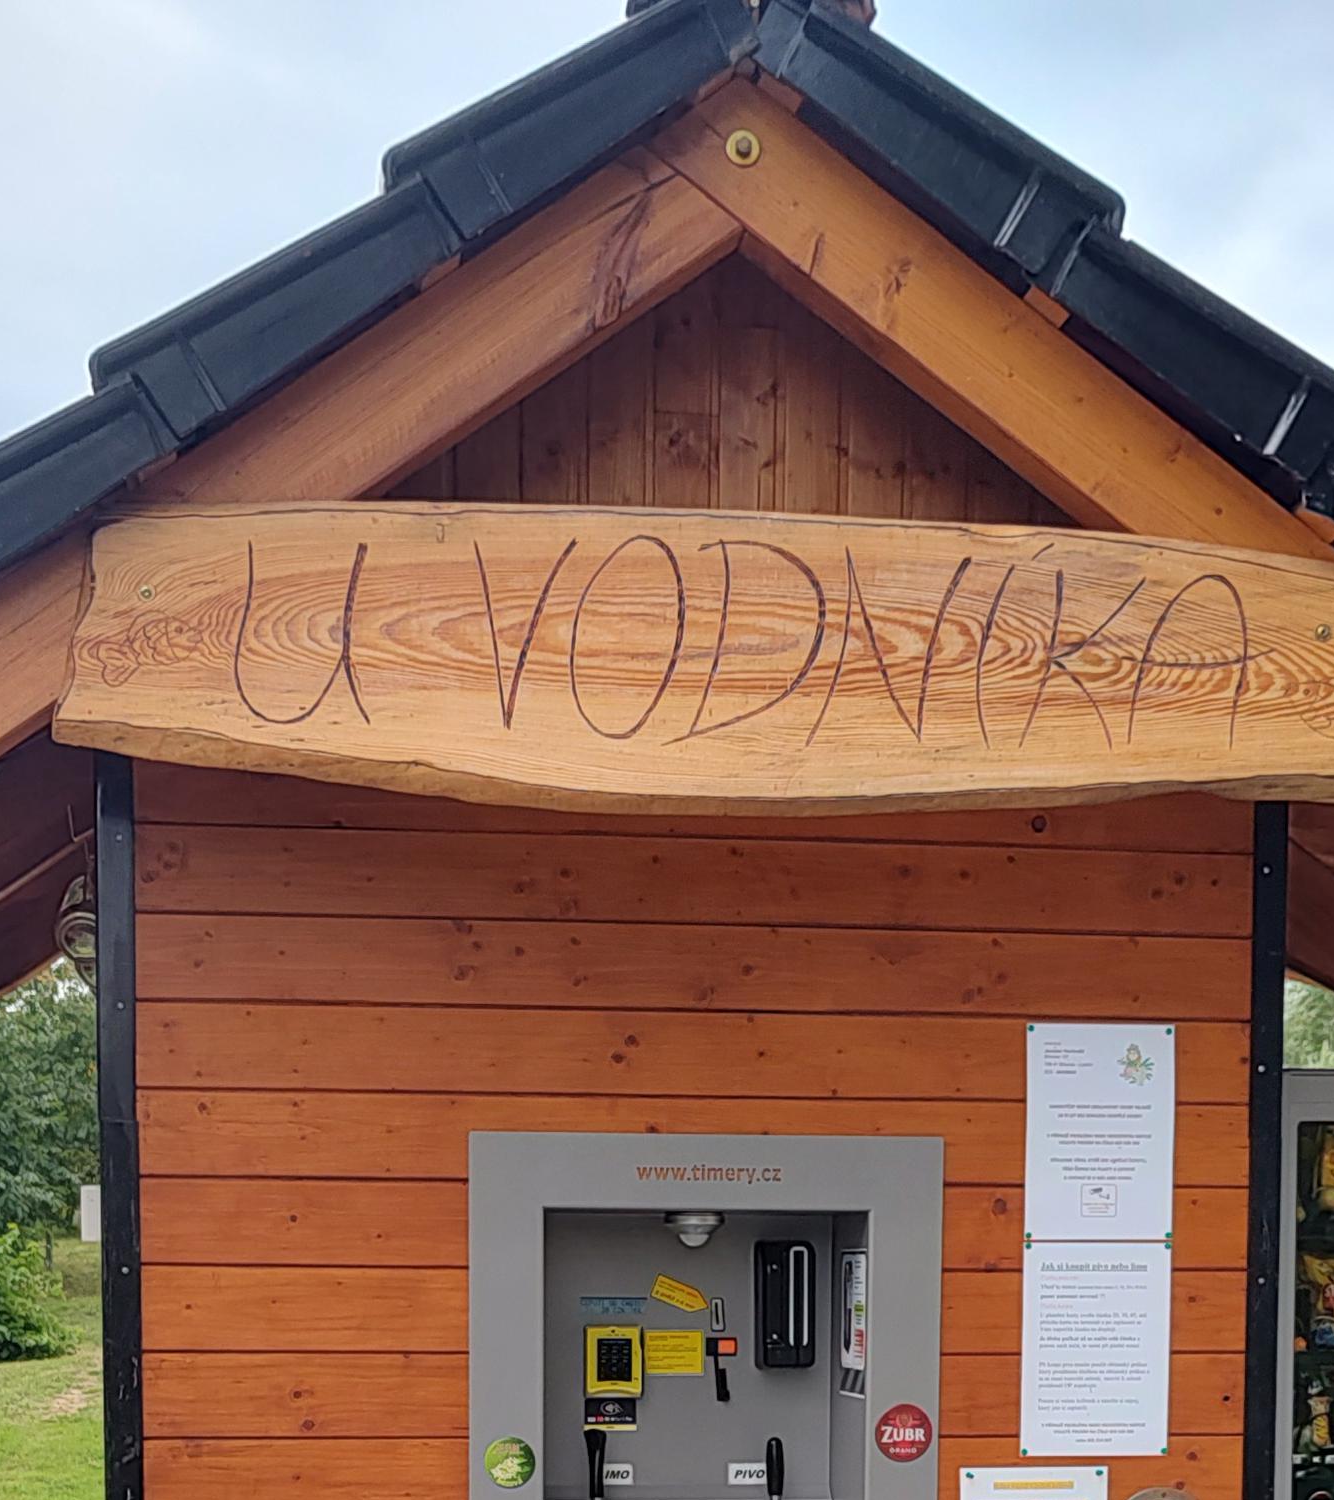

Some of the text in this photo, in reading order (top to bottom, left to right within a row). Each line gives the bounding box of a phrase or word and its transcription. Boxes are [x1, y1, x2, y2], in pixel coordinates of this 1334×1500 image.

[233, 540, 371, 725] U
[636, 1164, 782, 1184] www.timery.cz
[880, 1426, 926, 1443] ZUBR
[889, 1446, 917, 1454] GRAND
[604, 1469, 630, 1480] IMO
[734, 1469, 765, 1480] PIVO
